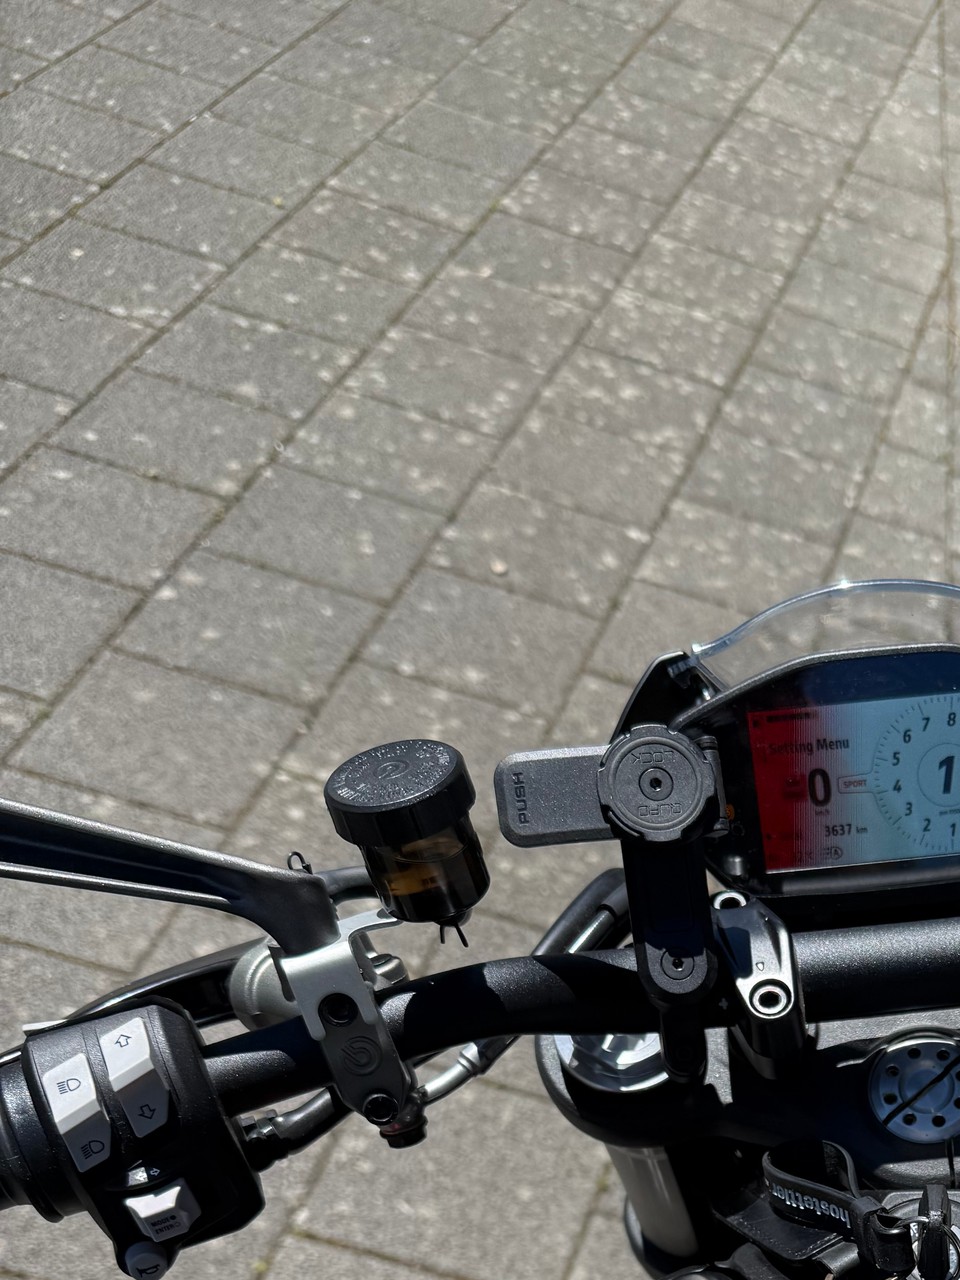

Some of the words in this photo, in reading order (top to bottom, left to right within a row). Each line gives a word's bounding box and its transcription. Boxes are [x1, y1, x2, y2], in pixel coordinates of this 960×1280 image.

[922, 717, 930, 732] 7
[947, 712, 956, 727] 8
[903, 729, 912, 743] 6
[816, 738, 849, 751] Menu
[631, 750, 674, 765] LOCK
[892, 752, 900, 766] 5
[938, 755, 955, 795] 1
[808, 768, 831, 807] 0
[843, 779, 867, 789] SPORT
[893, 779, 902, 793] 4
[512, 772, 530, 825] PUSH
[904, 802, 913, 816] 3
[824, 824, 852, 837] 3637
[922, 818, 931, 832] 2
[950, 823, 956, 837] 1
[771, 1182, 851, 1229] hostettler
